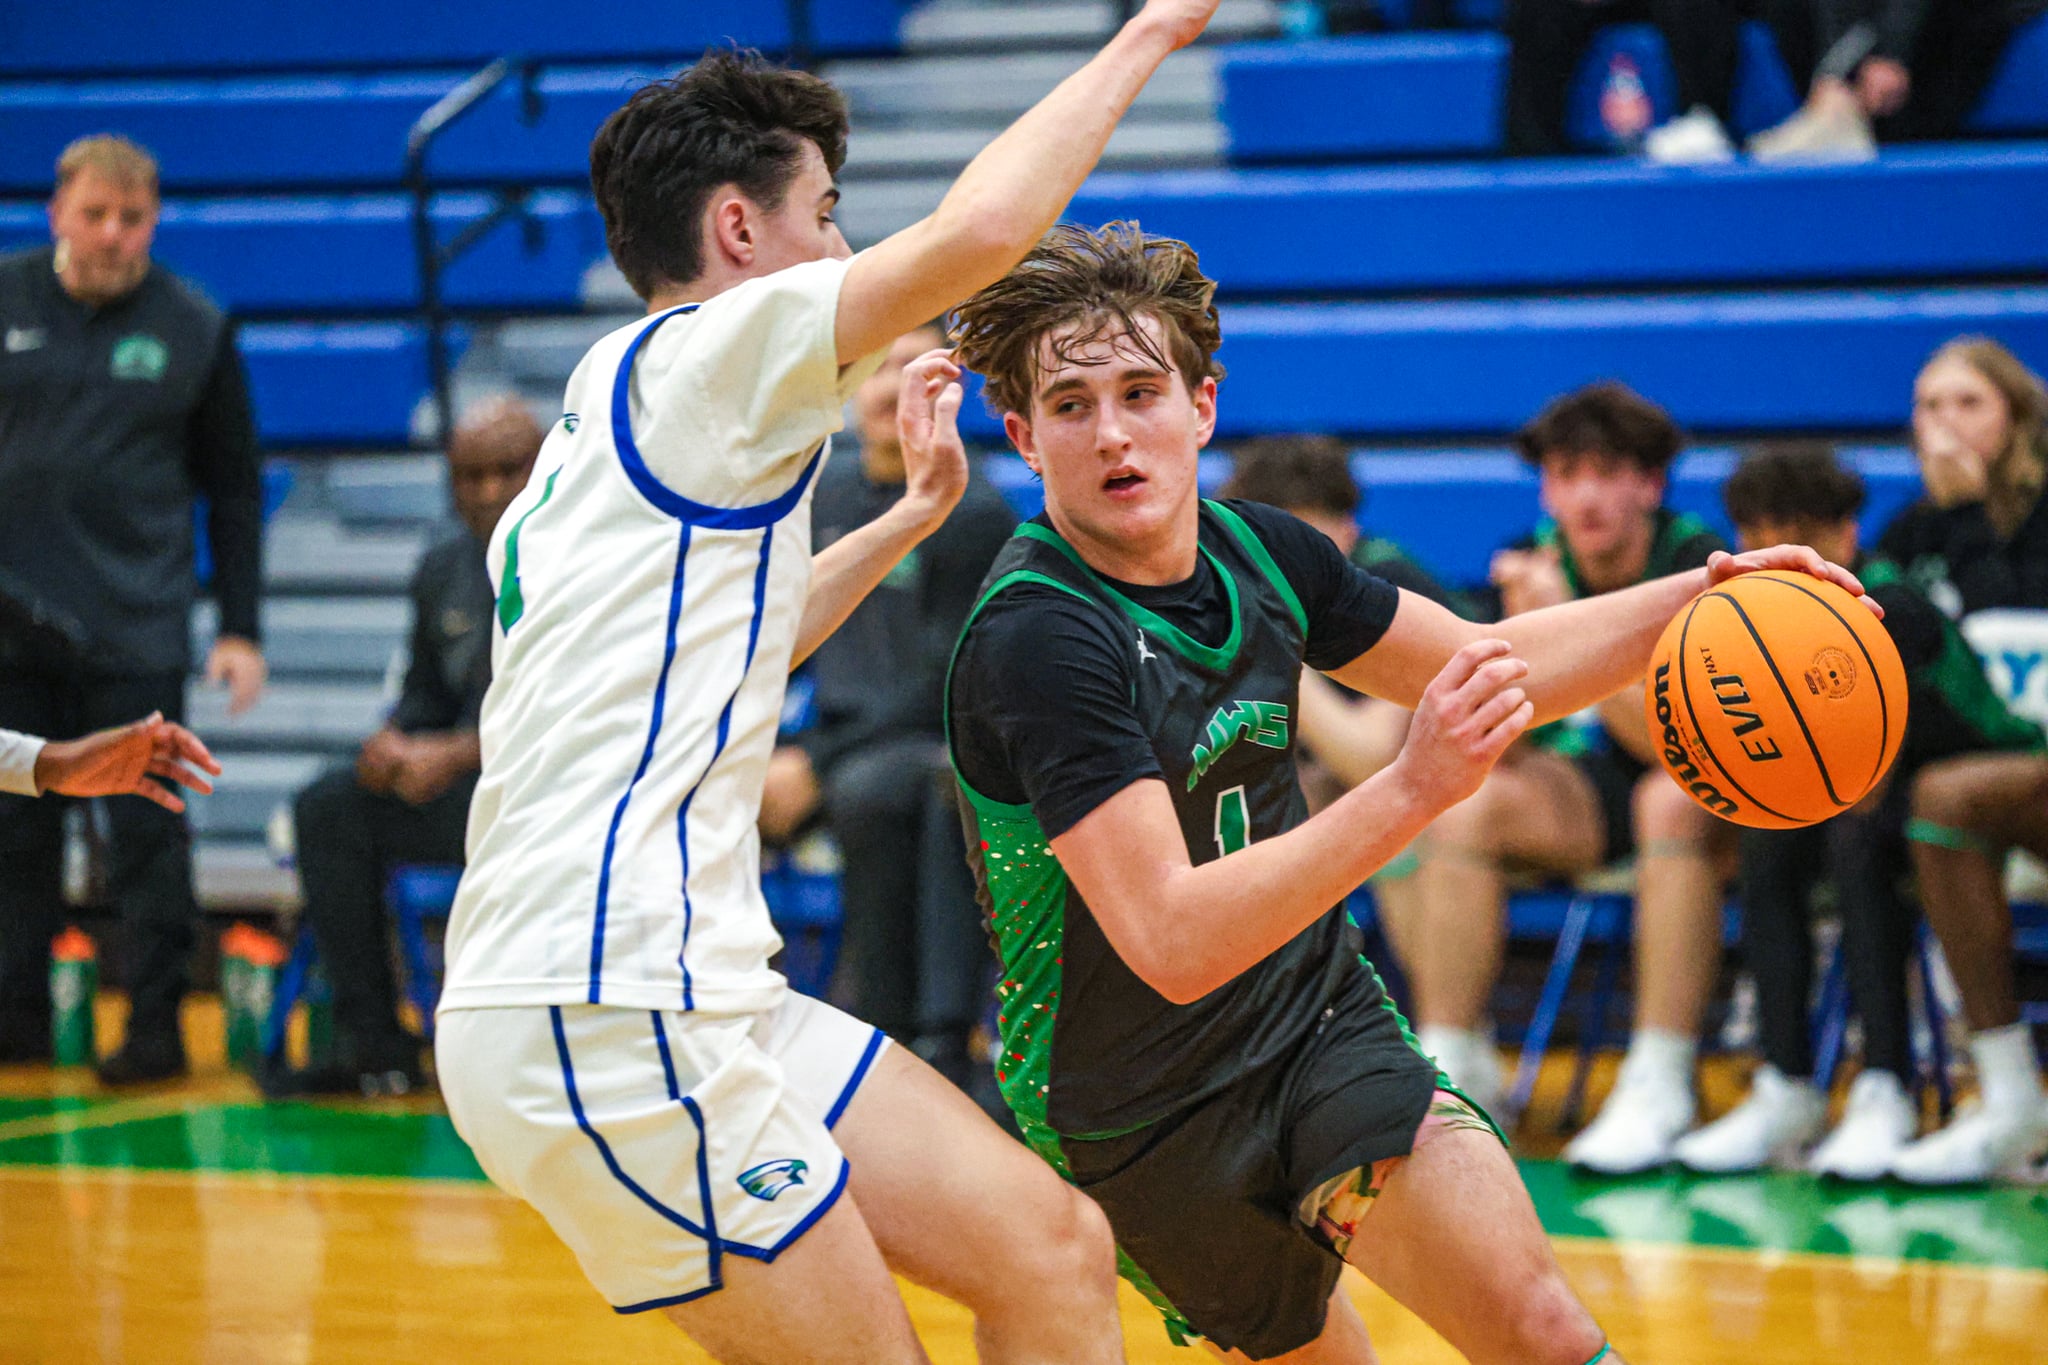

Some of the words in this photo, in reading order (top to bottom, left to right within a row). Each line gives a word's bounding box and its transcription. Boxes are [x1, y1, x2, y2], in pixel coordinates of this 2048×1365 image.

[1700, 646, 1718, 674] NXT
[1654, 659, 1740, 819] Wilson
[1709, 674, 1784, 763] EVO
[1213, 784, 1251, 859] 1
